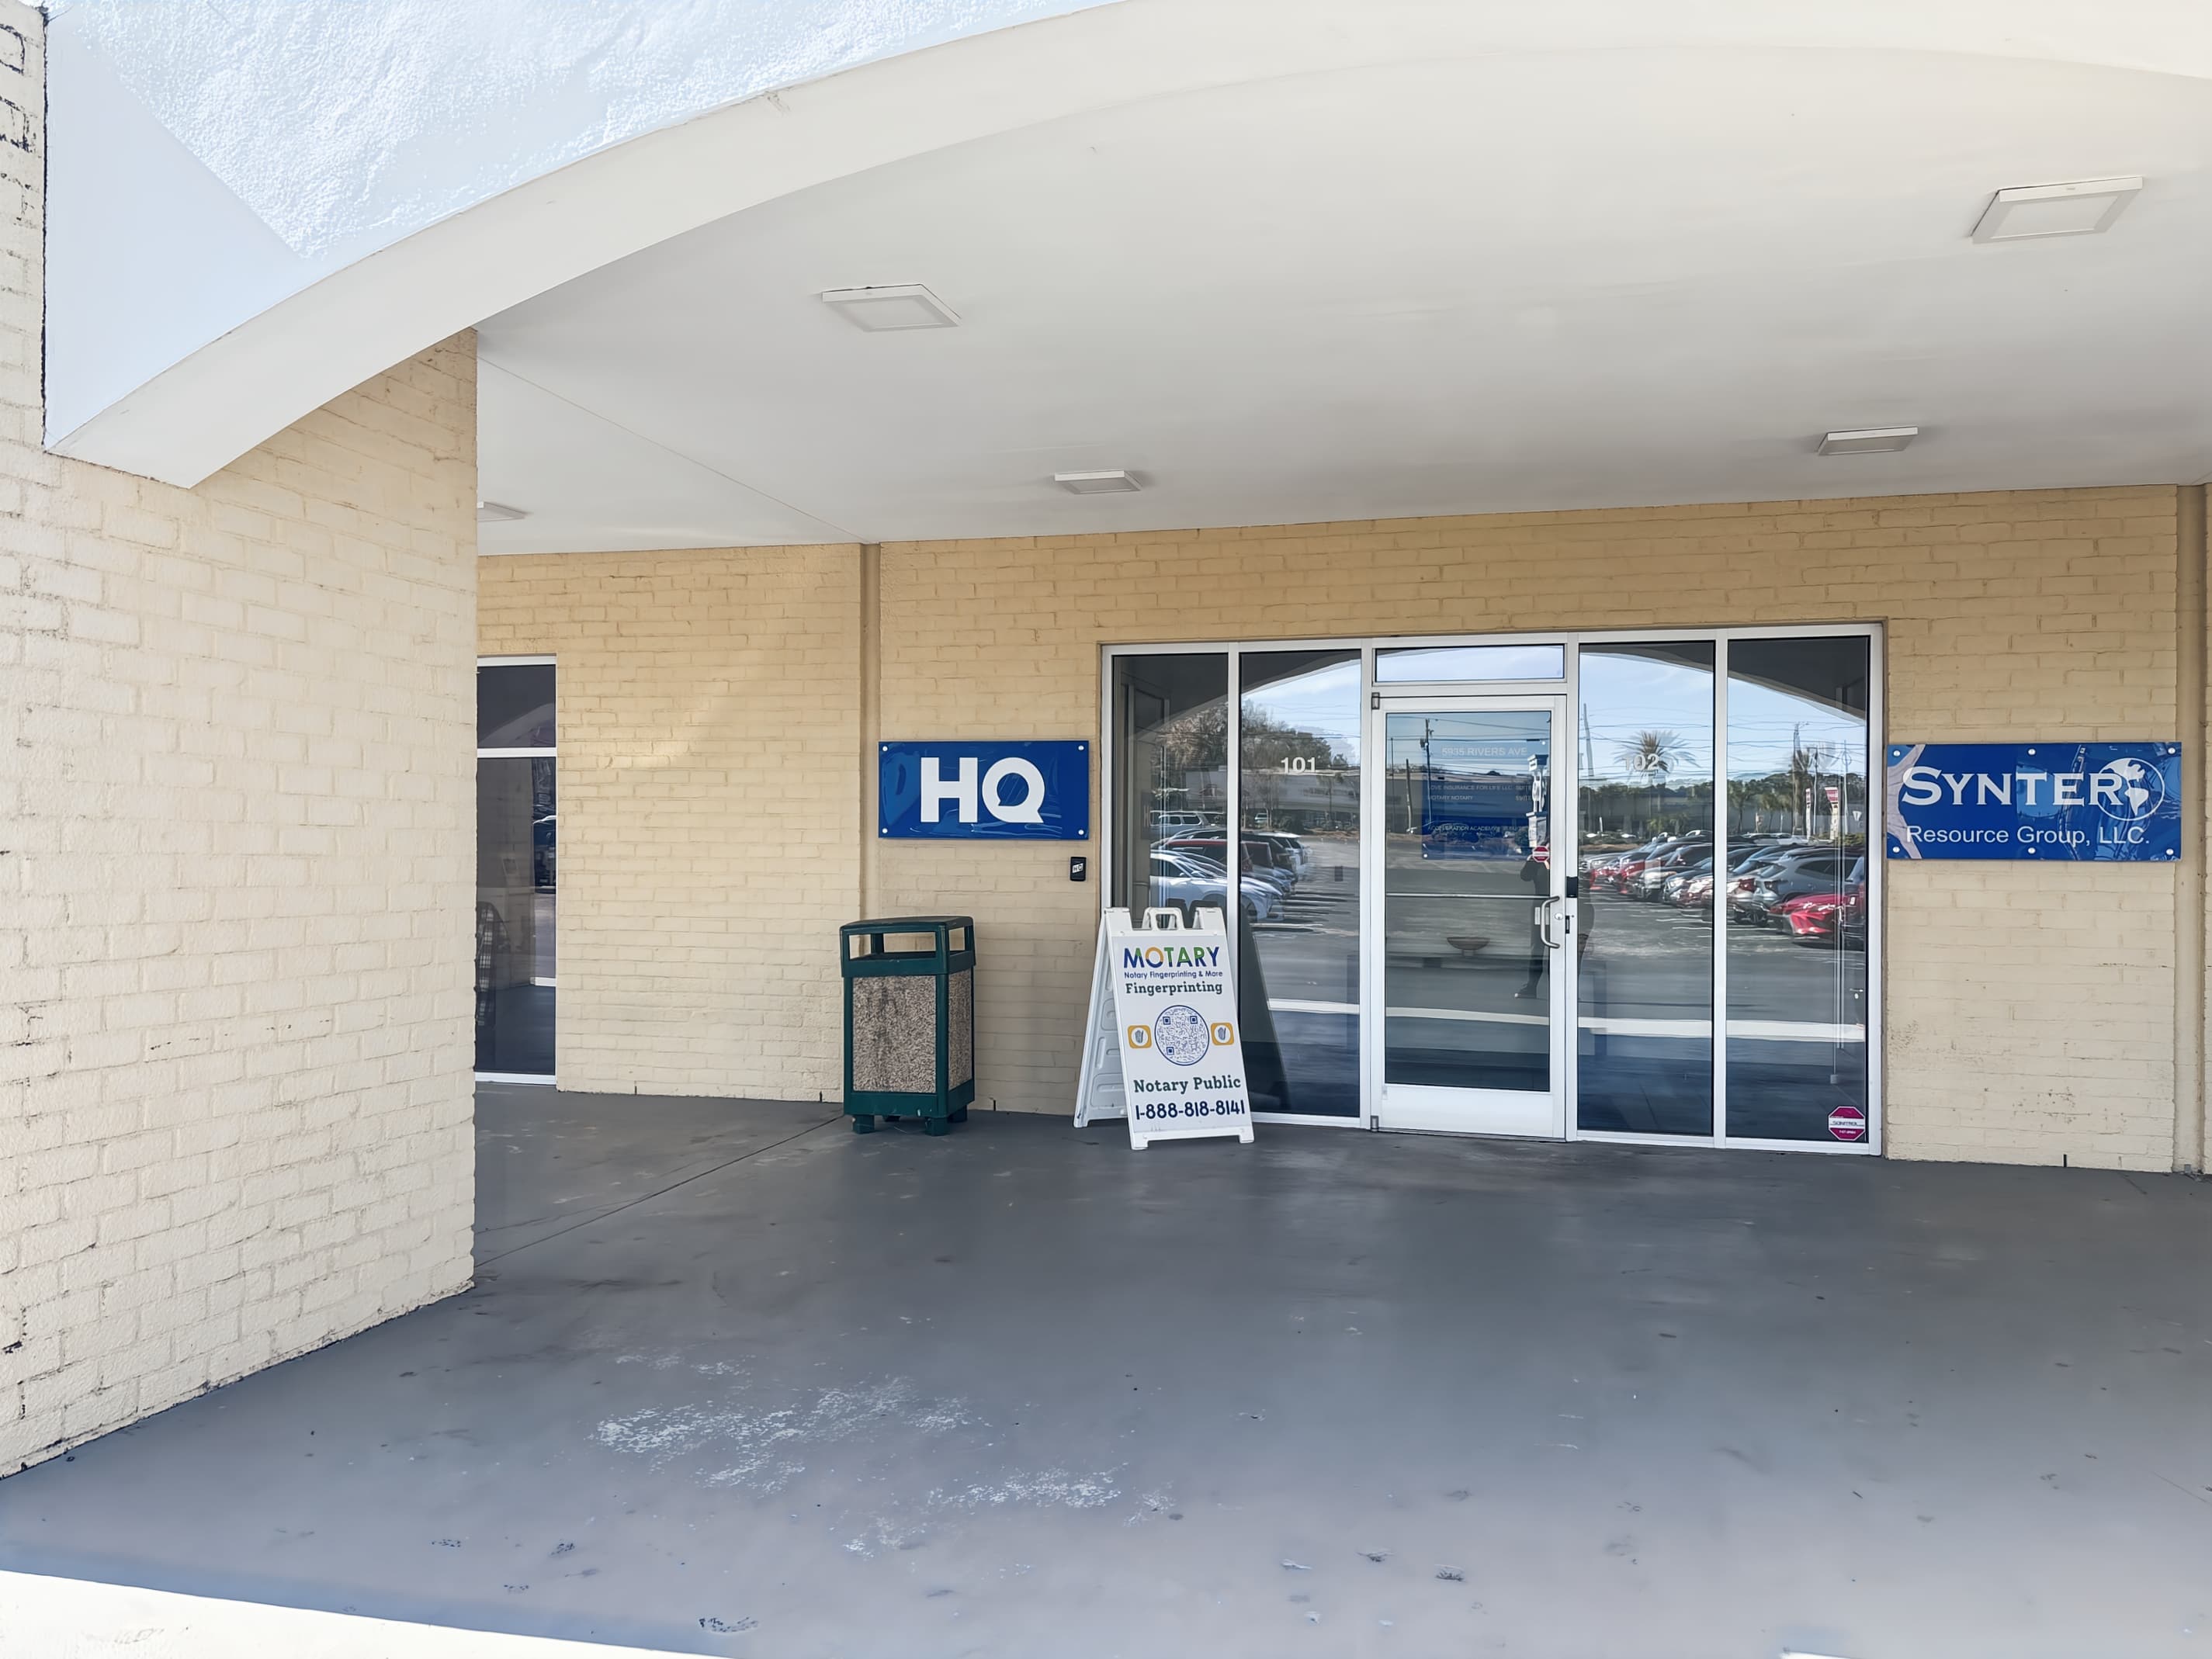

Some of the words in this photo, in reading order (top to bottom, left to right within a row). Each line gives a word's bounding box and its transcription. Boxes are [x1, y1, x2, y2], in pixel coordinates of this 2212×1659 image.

[1467, 747, 1505, 756] RIVERS
[1506, 747, 1527, 756] AVE
[1280, 757, 1316, 774] 101
[1624, 753, 1659, 771] 102
[921, 757, 1045, 823] HQ
[1902, 766, 2124, 806] SYNTER
[1906, 826, 2009, 844] Resource
[2017, 826, 2091, 847] Group,
[2099, 826, 2150, 844] LLC.
[1123, 946, 1220, 968] MOTARY
[1124, 971, 1148, 979] Notary
[1149, 971, 1197, 979] Fingerprinting
[1125, 981, 1223, 996] Fingerprinting
[1133, 1079, 1188, 1095] Notary
[1193, 1075, 1241, 1090] Public
[1135, 1100, 1246, 1120] 1-888-818-8141
